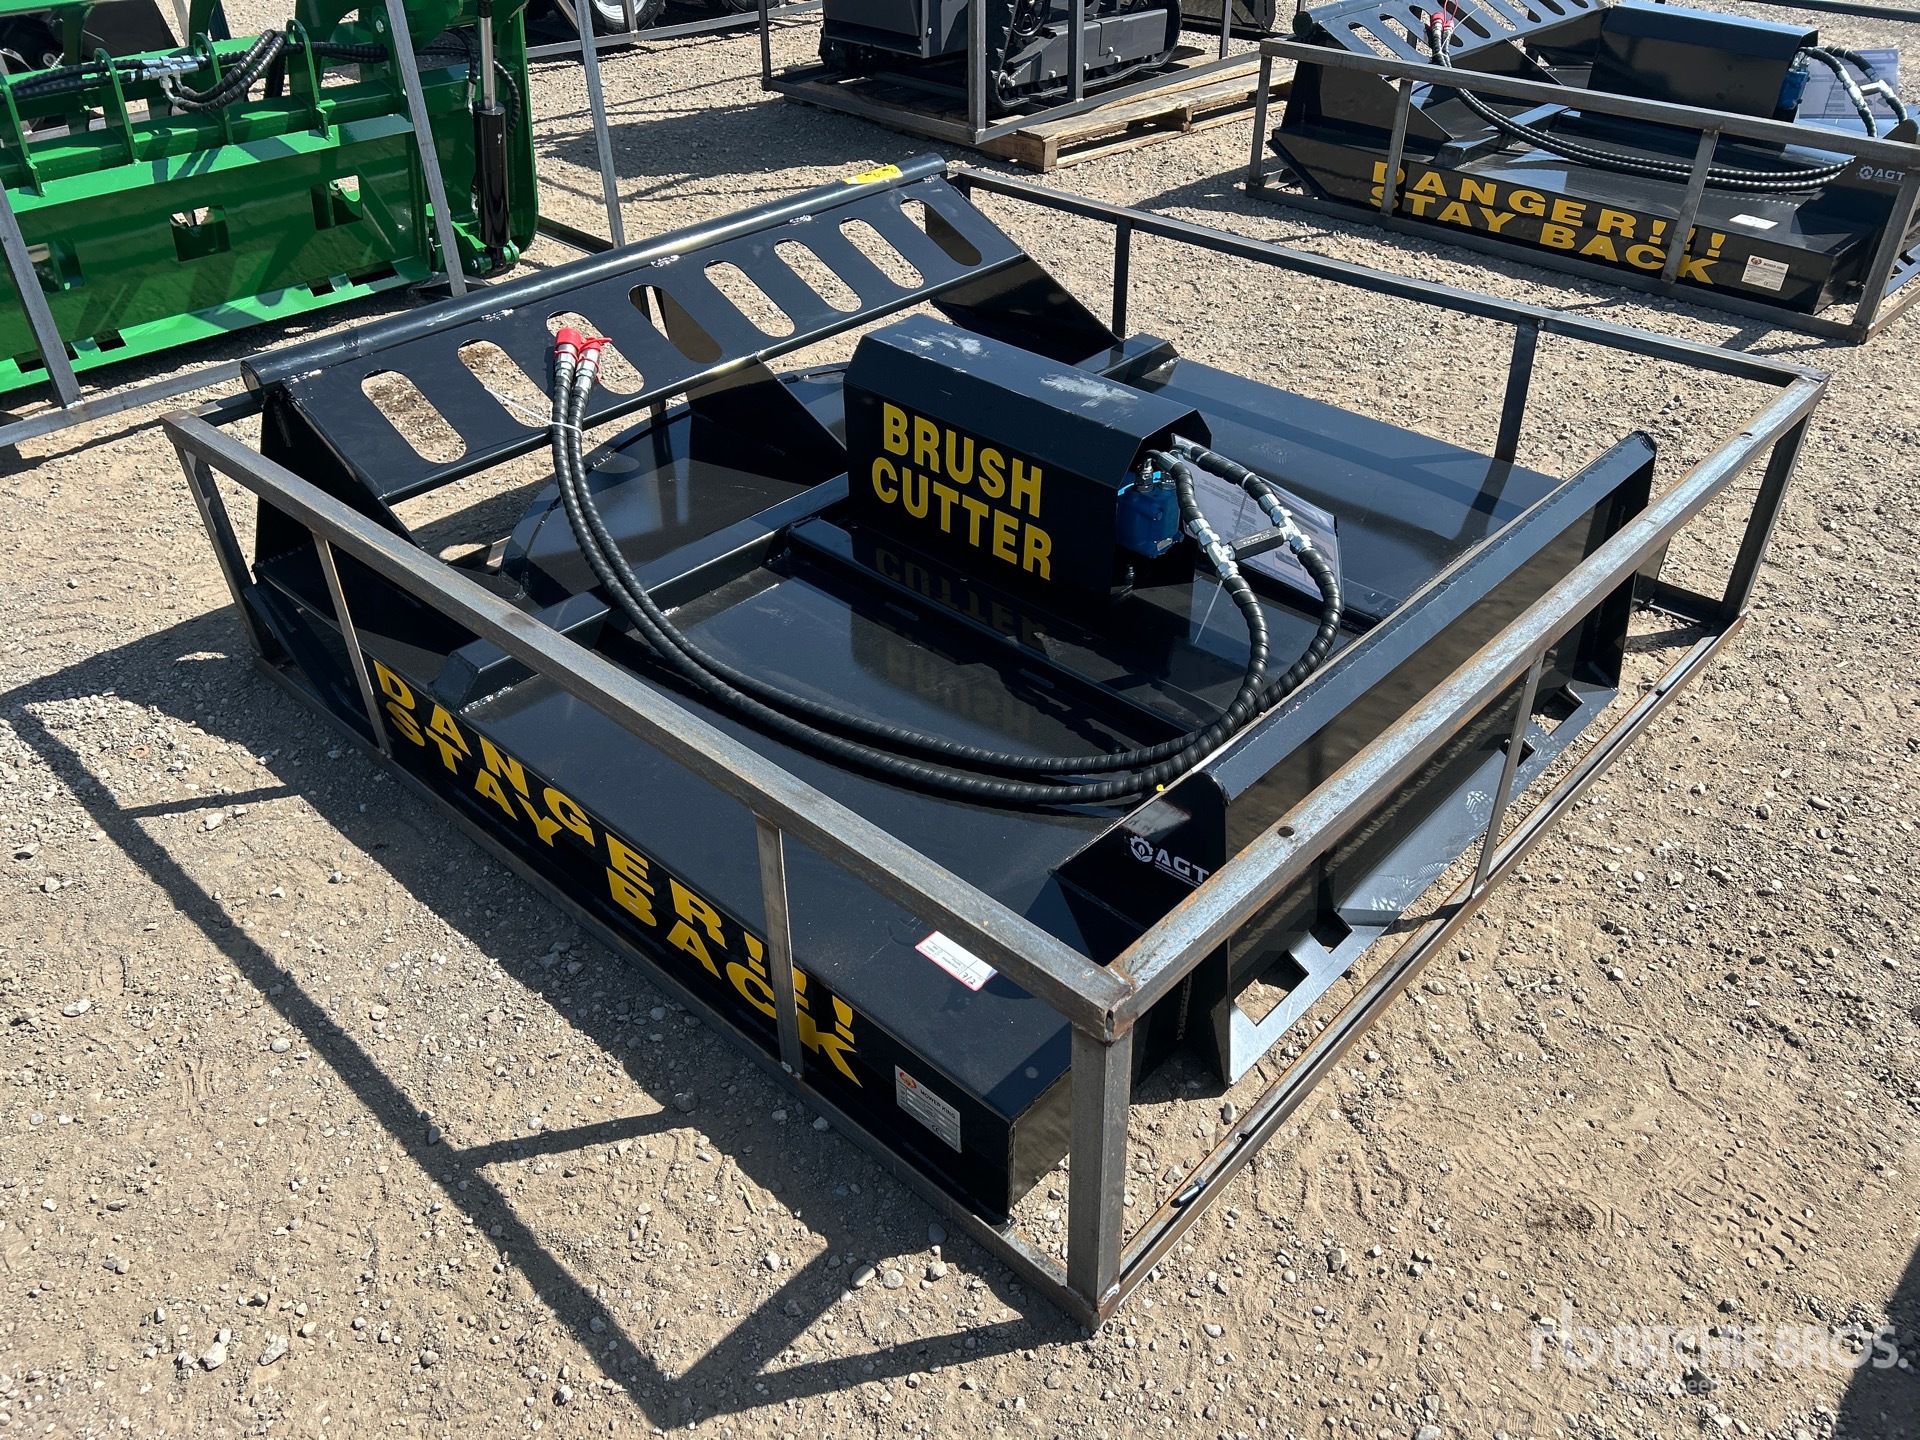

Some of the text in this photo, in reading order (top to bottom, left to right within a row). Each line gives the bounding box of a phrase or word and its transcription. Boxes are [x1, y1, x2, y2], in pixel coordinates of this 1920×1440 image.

[1874, 168, 1905, 181] AGT
[1369, 186, 1719, 284] STAY BACK
[884, 402, 1042, 518] BRUSH
[872, 457, 1052, 580] CUTTER
[373, 660, 855, 1044] DANGER!!!
[386, 701, 863, 1088] STAY BACK
[1156, 848, 1209, 883] AGT
